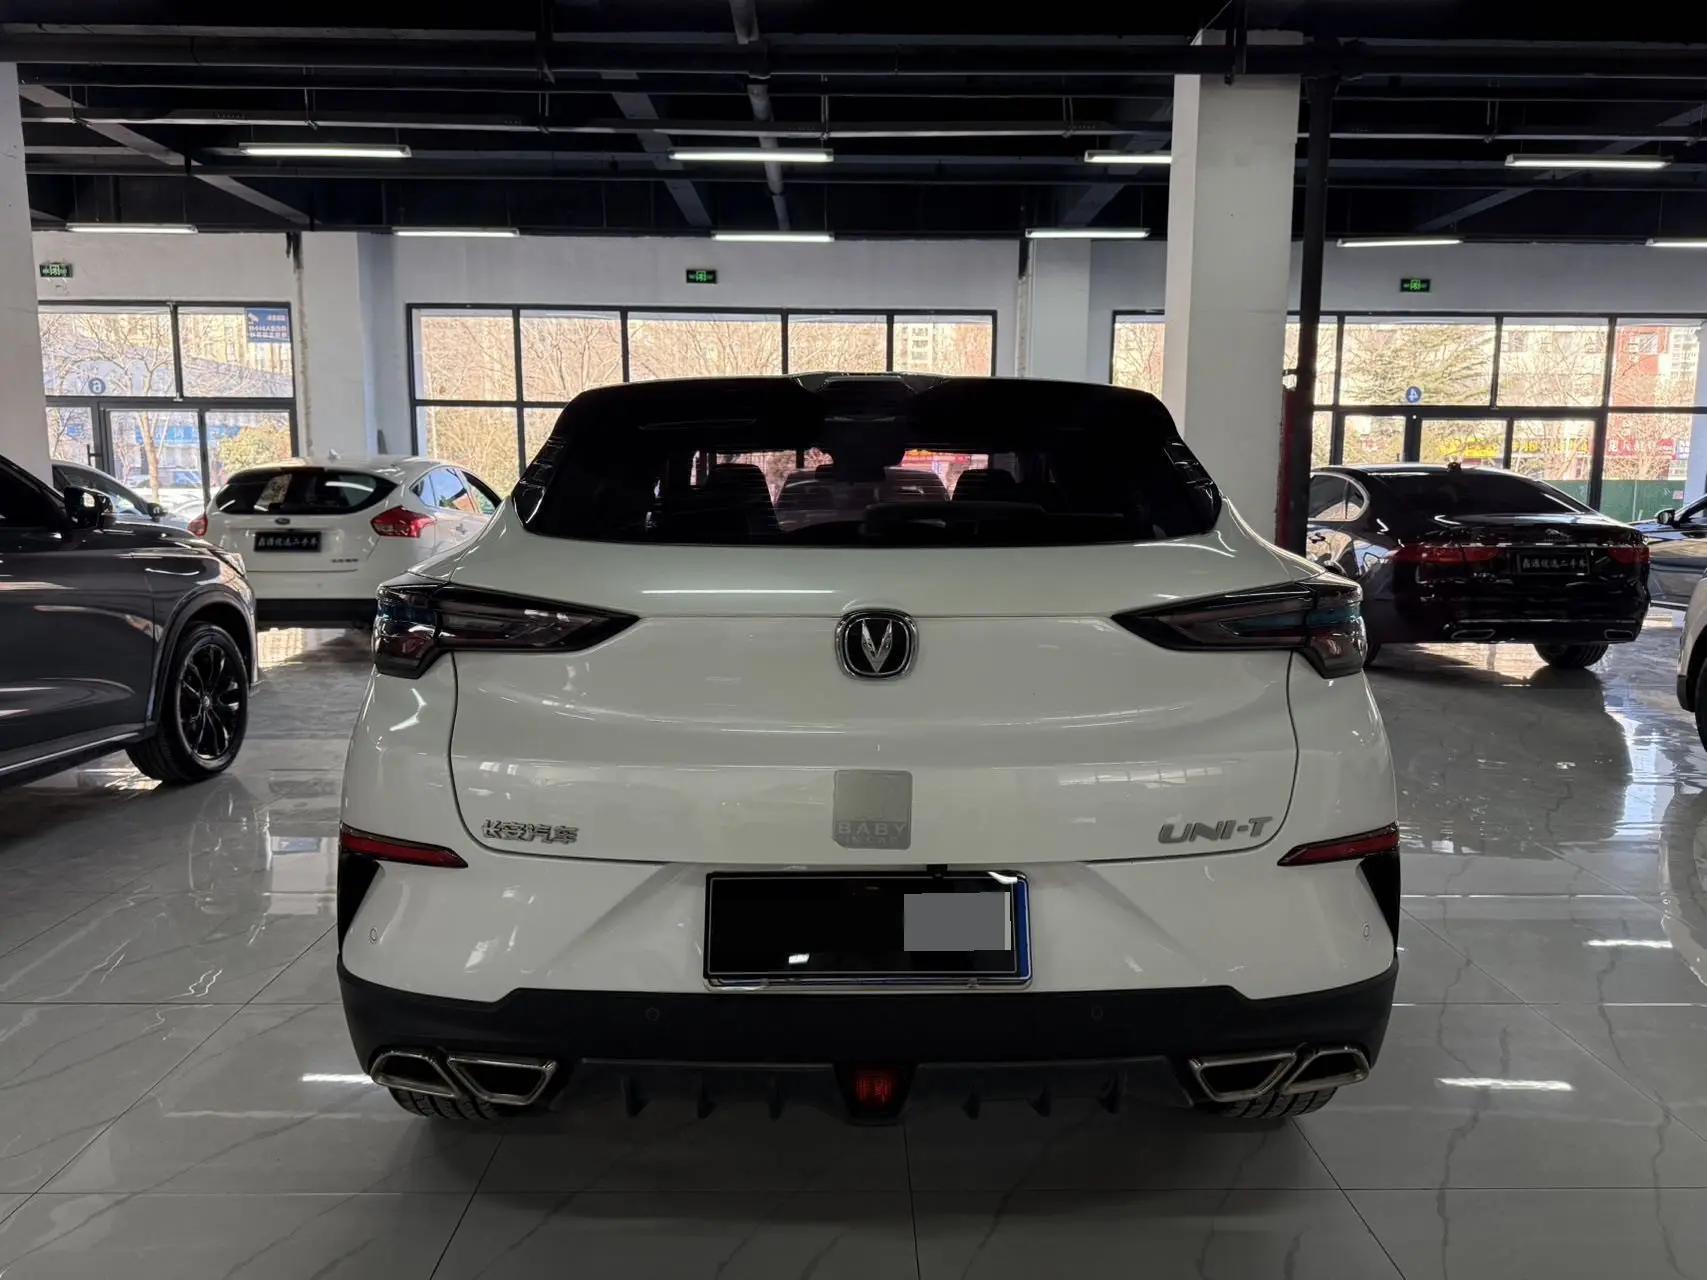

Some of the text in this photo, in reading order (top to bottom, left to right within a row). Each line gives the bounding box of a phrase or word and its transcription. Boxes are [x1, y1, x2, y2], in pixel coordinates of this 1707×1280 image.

[481, 818, 579, 844] 长安汽车
[838, 822, 907, 836] BABY
[1157, 816, 1273, 844] UNI-T
